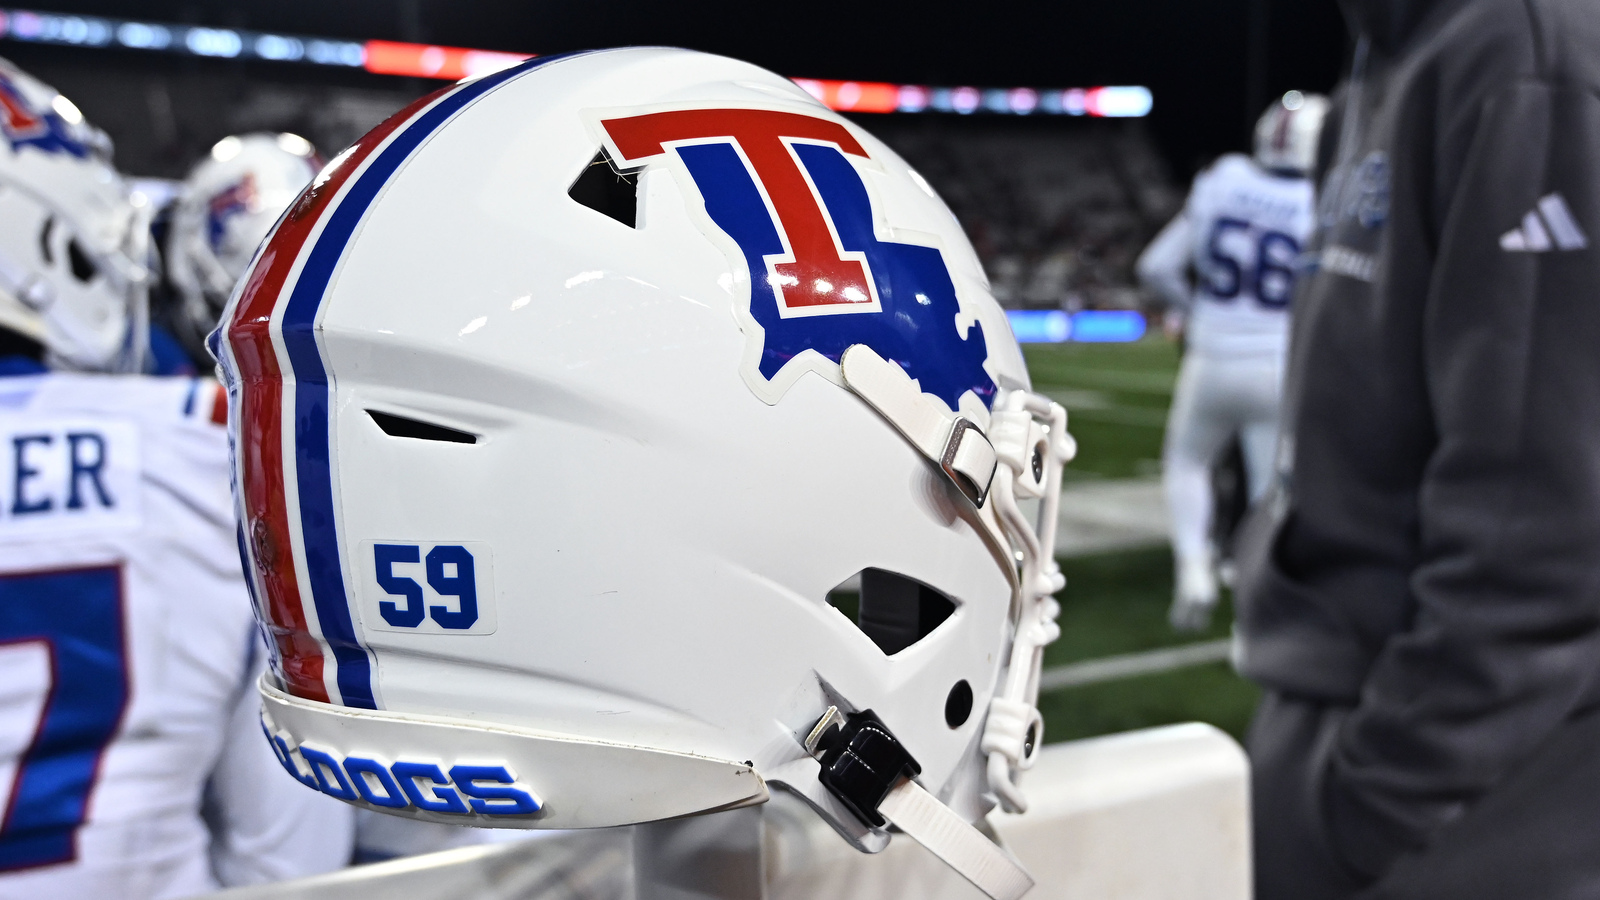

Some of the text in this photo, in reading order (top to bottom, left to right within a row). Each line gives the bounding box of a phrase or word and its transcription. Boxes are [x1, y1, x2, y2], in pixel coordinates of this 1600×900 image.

[1202, 217, 1300, 308] 56
[0, 432, 115, 515] ER
[373, 544, 479, 630] 59
[260, 712, 542, 814] LDOGS
